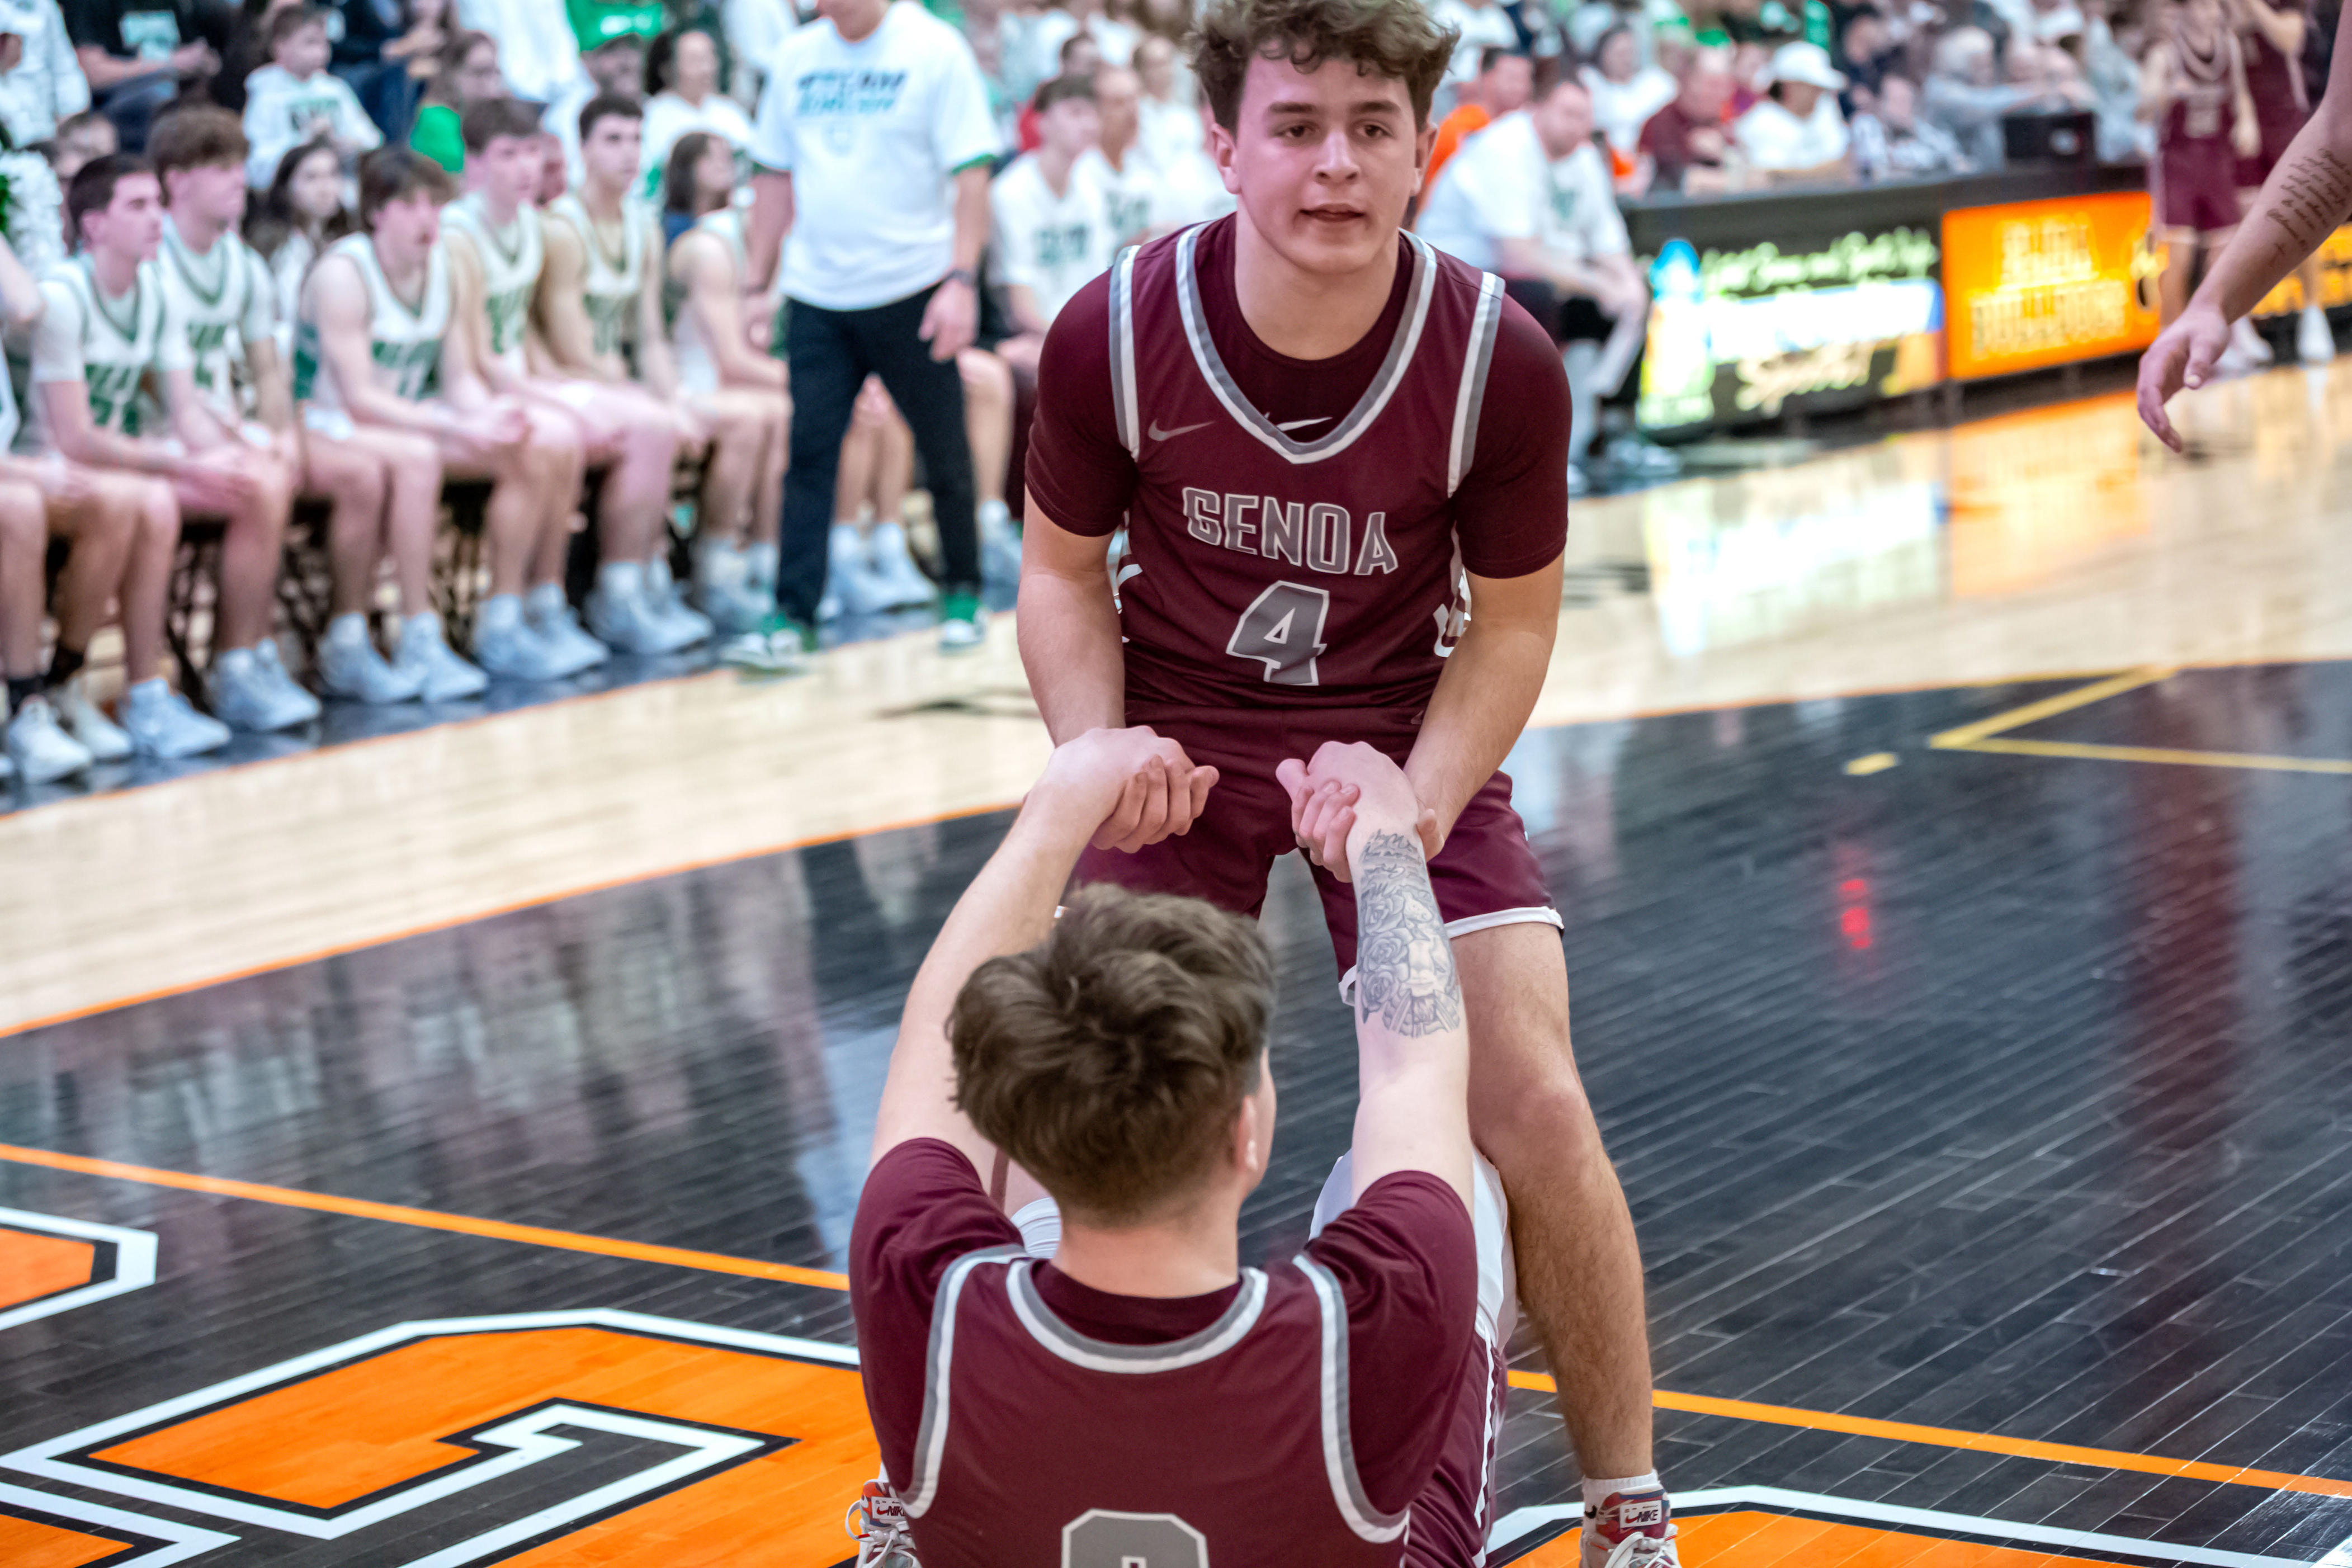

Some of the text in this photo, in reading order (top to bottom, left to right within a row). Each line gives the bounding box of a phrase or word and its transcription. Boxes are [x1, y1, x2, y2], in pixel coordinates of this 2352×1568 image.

[1182, 487, 1399, 576] GENOA
[1226, 580, 1330, 686] 4
[1637, 1509, 1659, 1523] NIKE
